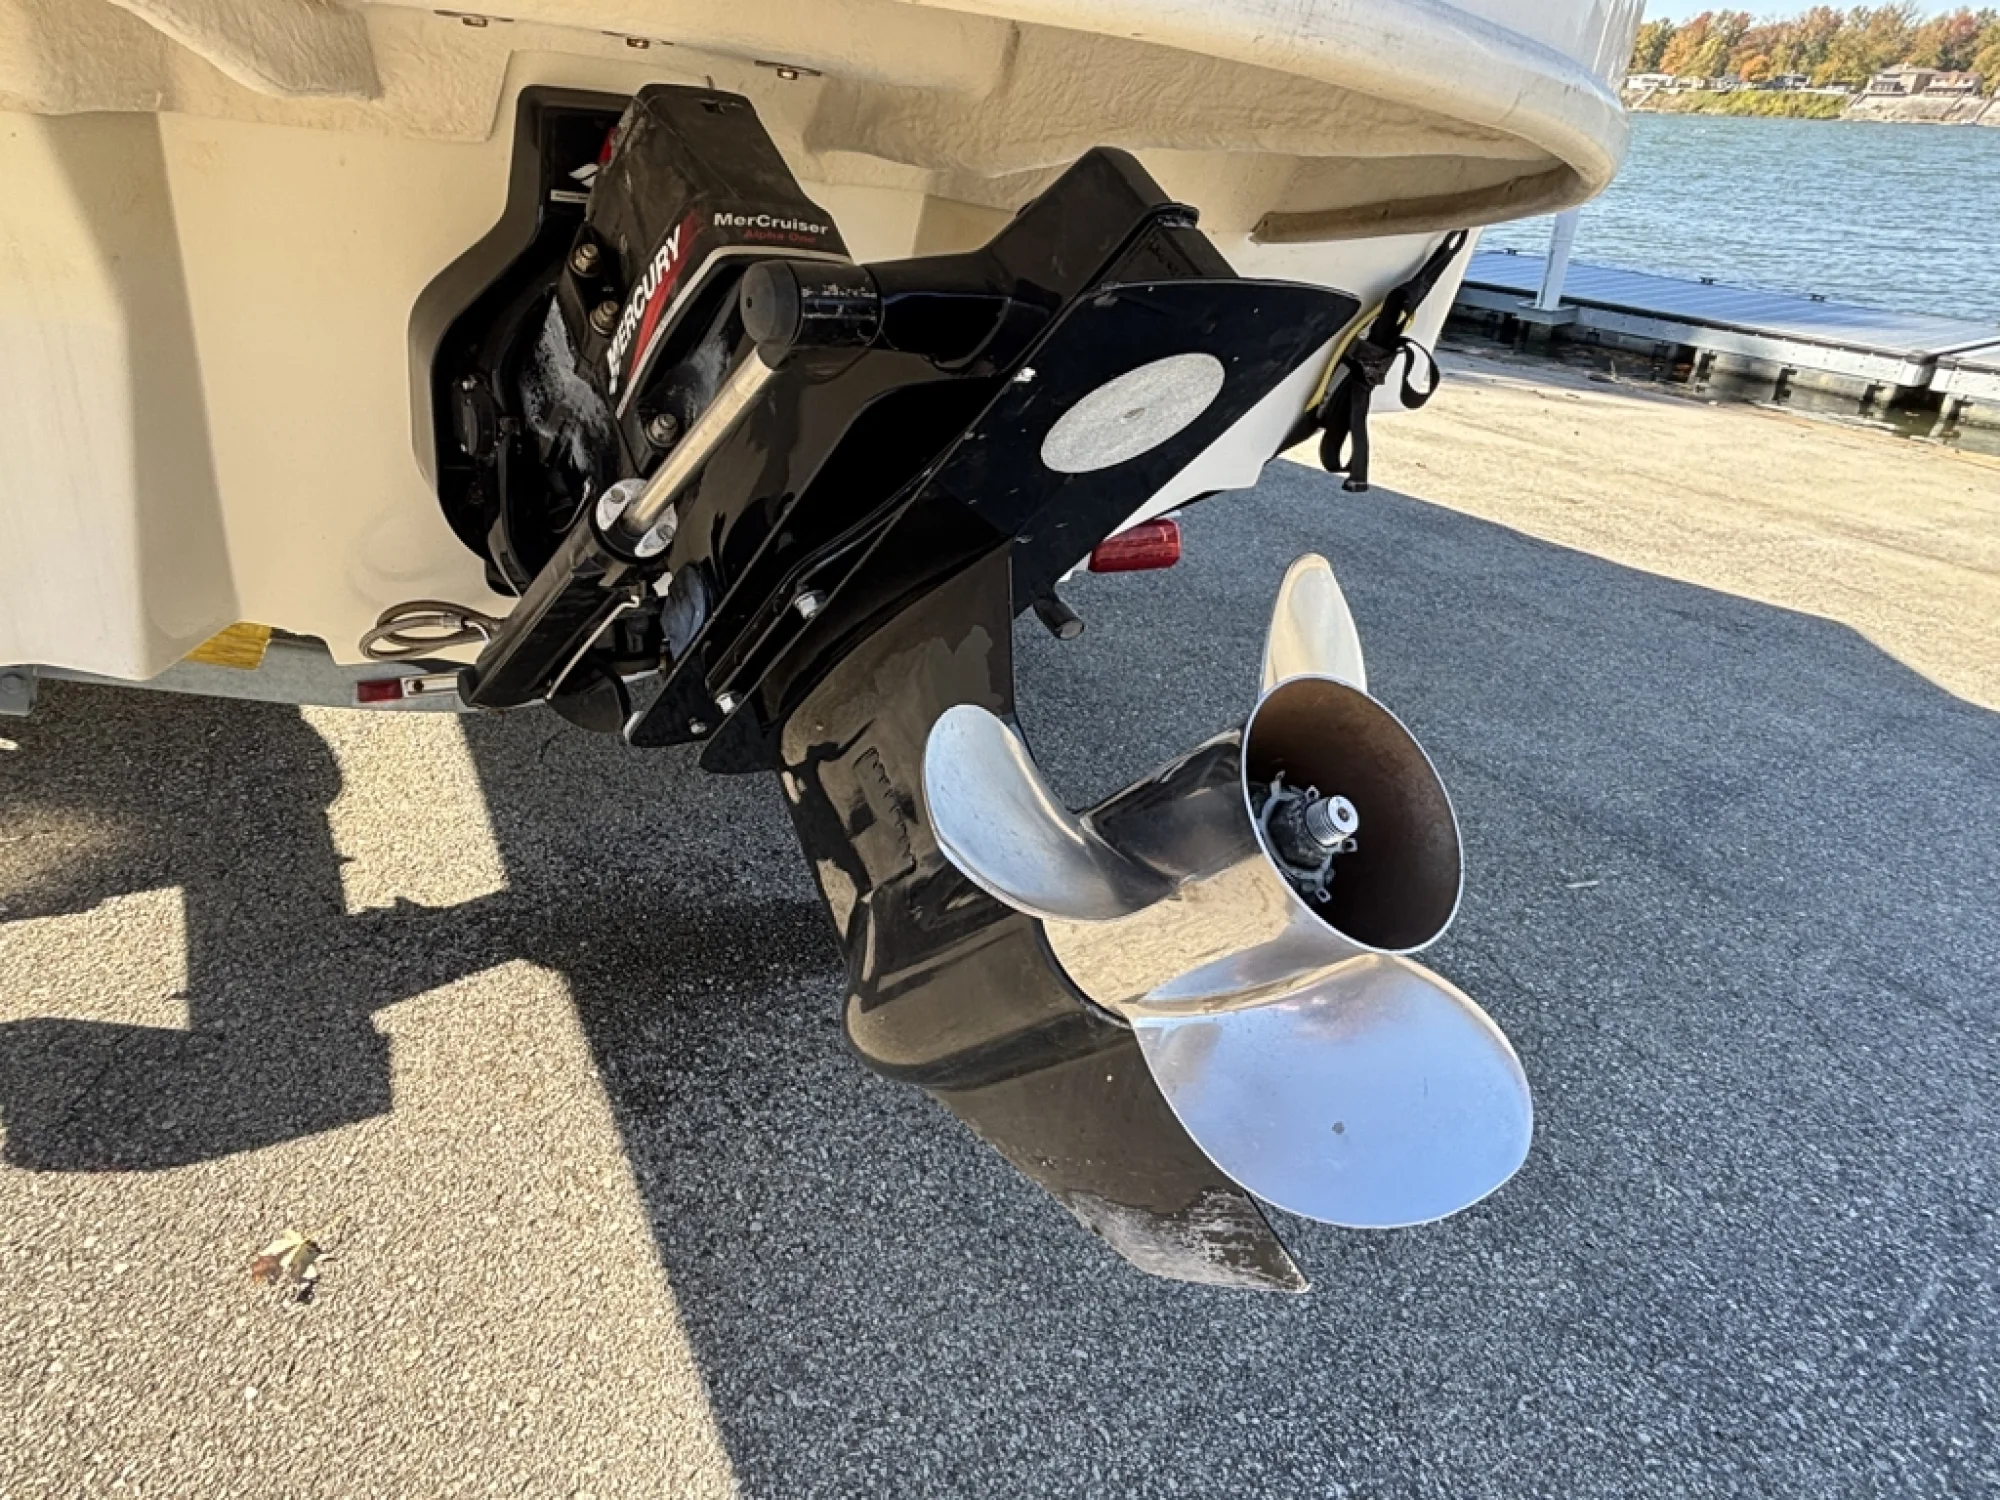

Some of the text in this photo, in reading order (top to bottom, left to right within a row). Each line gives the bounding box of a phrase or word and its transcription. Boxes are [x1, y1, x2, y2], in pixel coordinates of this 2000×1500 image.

[714, 212, 828, 235] MerCruiser
[743, 228, 784, 240] Alpha
[607, 224, 680, 380] MERCURY
